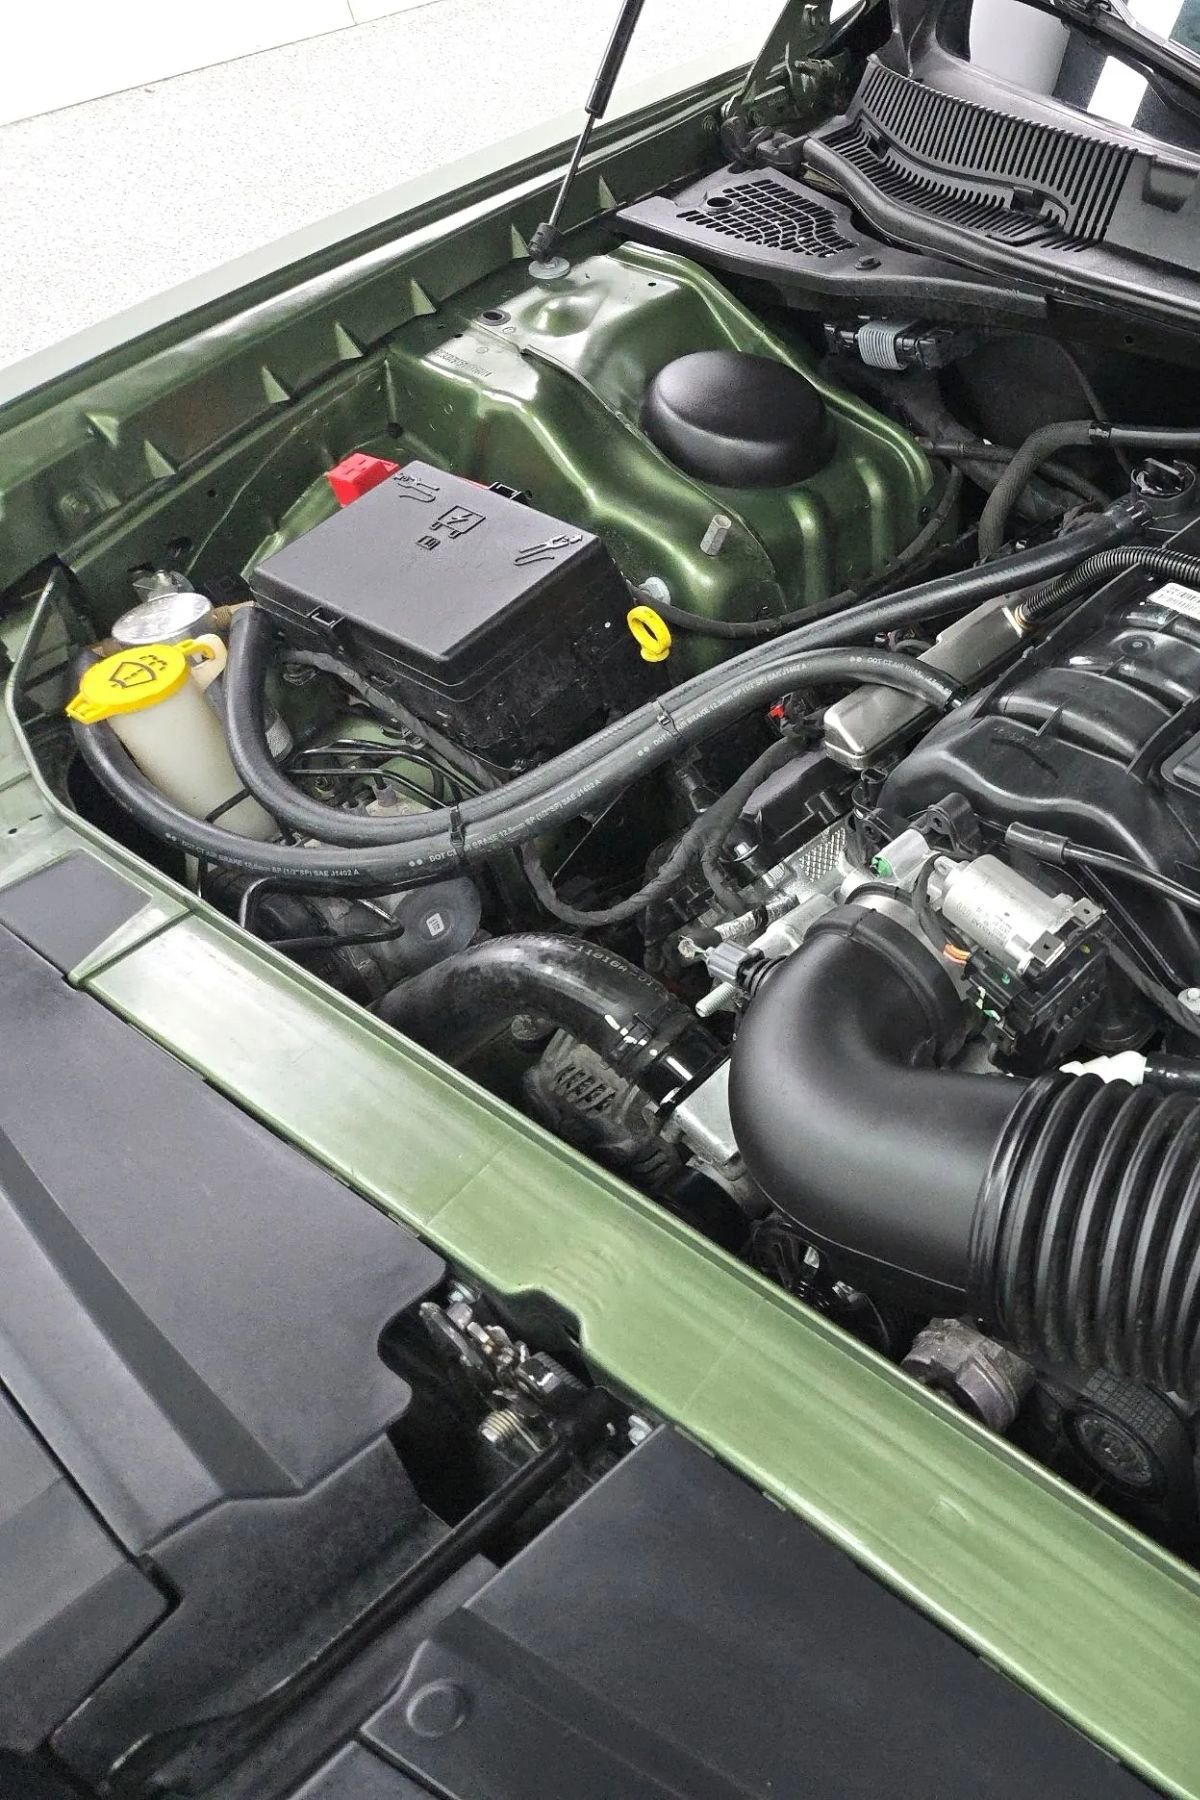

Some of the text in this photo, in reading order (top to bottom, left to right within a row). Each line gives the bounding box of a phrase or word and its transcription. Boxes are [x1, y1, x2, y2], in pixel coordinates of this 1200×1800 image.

[653, 733, 667, 746] DOT
[687, 707, 710, 725] BRAKE
[429, 852, 446, 862] DOT
[472, 833, 499, 848] BRAKE
[314, 869, 329, 878] SAE
[330, 869, 352, 878] J1402
[353, 867, 360, 876] A
